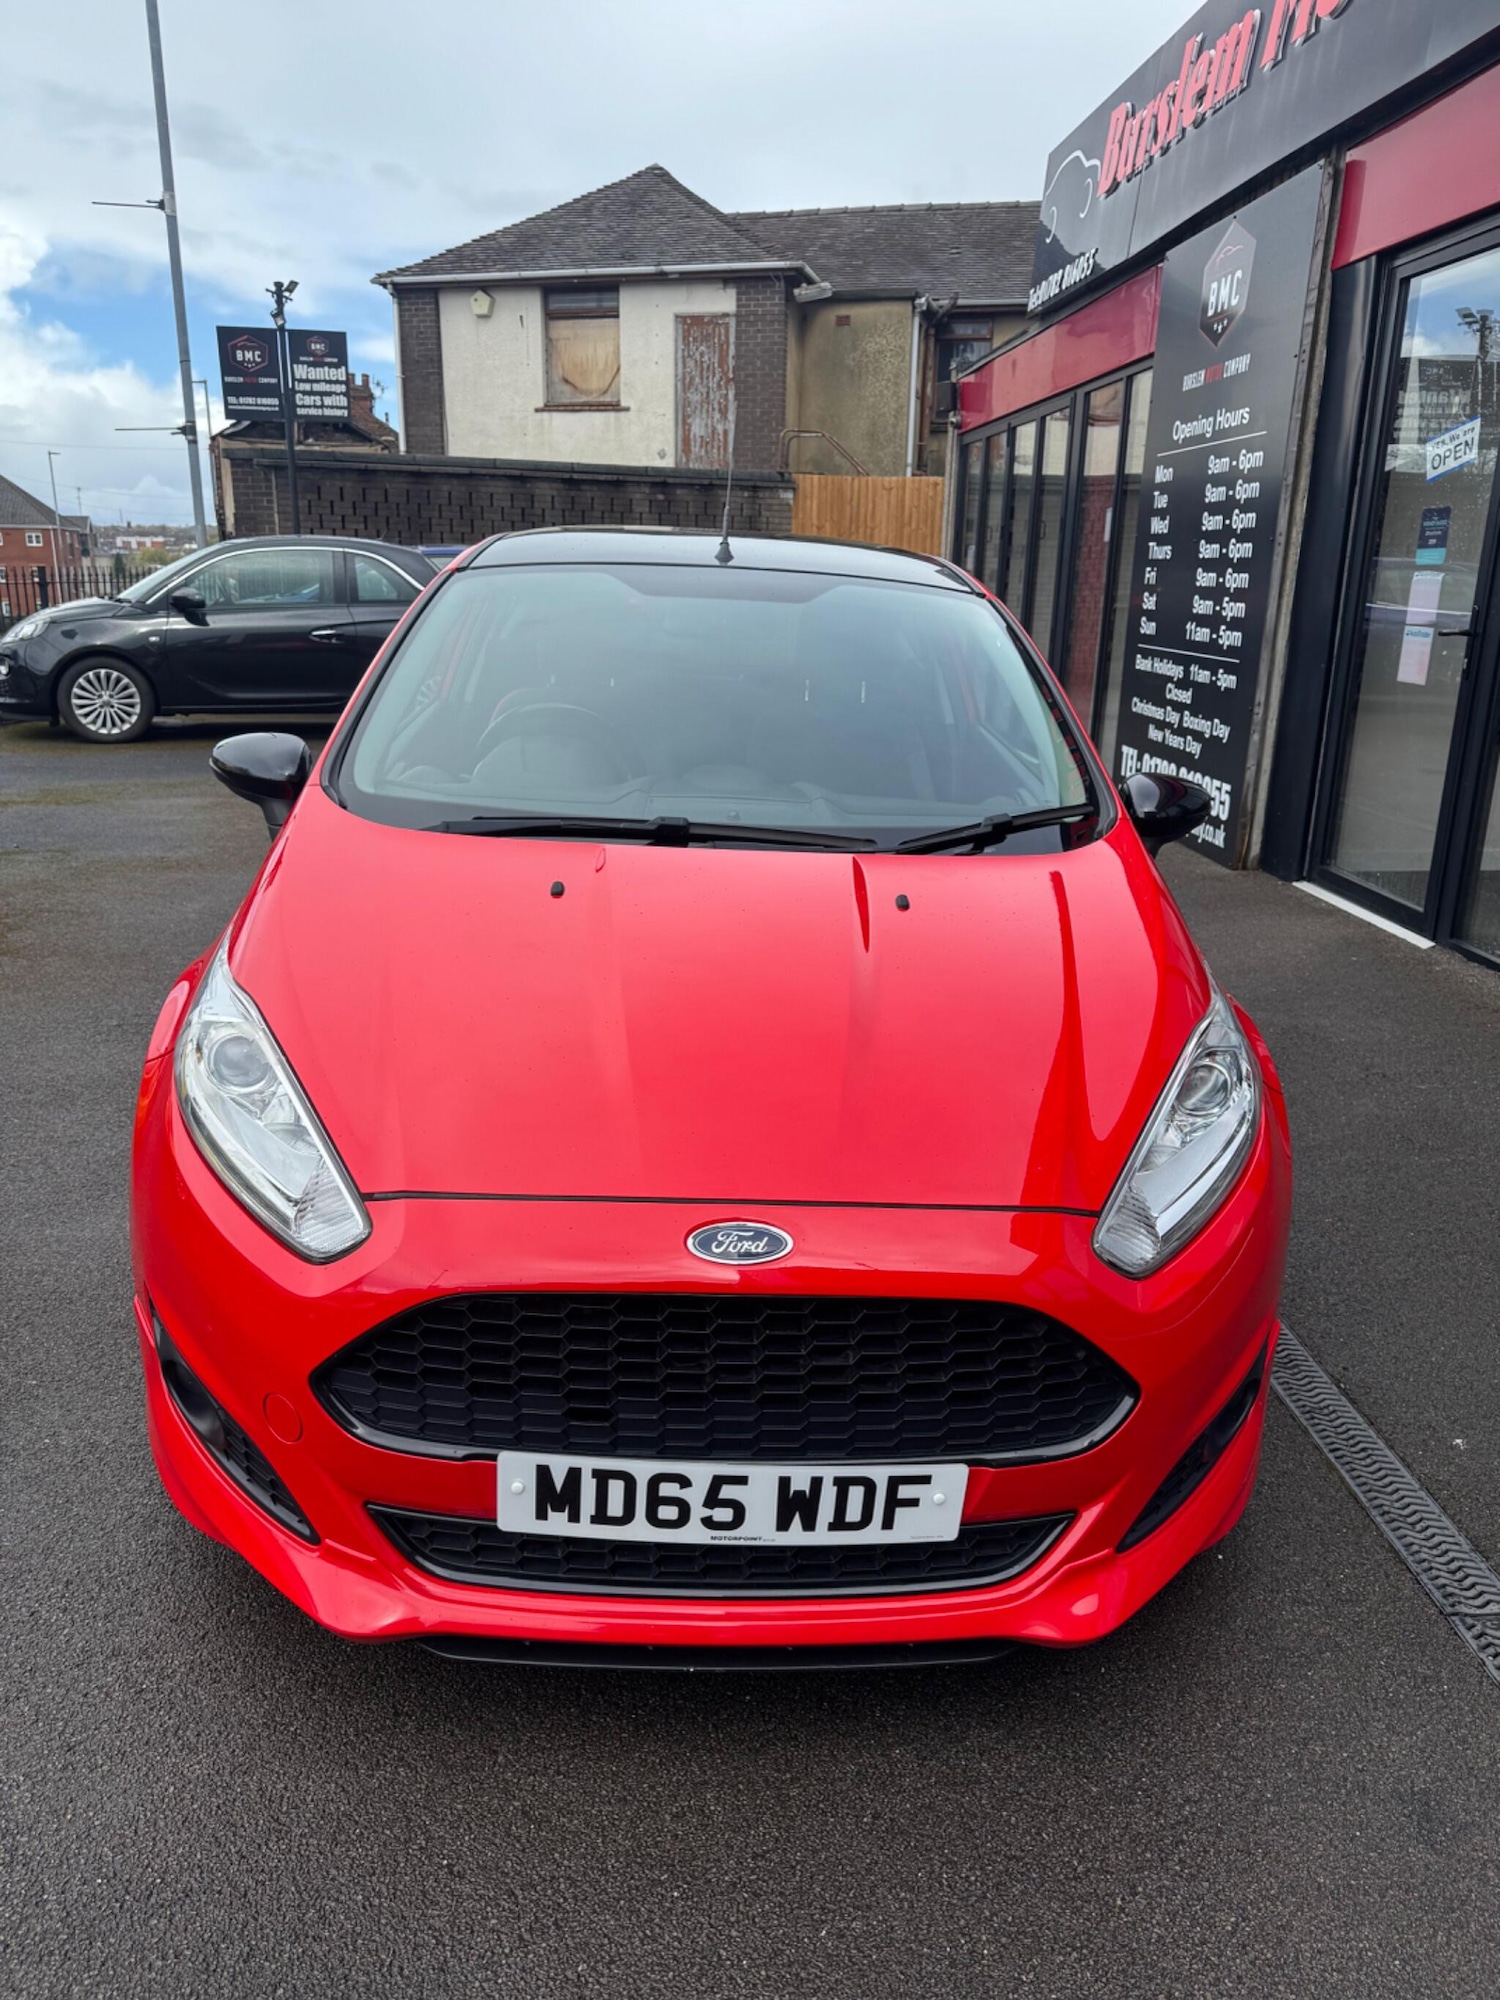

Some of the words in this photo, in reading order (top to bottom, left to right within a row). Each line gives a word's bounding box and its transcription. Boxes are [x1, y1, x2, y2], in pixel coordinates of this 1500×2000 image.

[1097, 9, 1260, 198] Burslem
[1207, 269, 1243, 318] BMC
[236, 349, 262, 362] BMC
[293, 363, 347, 381] Wanted
[294, 380, 312, 392] Low
[312, 381, 347, 393] mileage
[295, 393, 322, 407] Cars
[322, 394, 348, 407] with
[296, 407, 322, 417] service
[322, 408, 349, 418] history
[1172, 414, 1214, 445] Opening
[1215, 407, 1250, 431] Hours
[1155, 465, 1174, 484] Mon
[1207, 455, 1230, 475] 9am
[1238, 449, 1264, 474] 6pm
[1431, 437, 1475, 471] OPEN
[1153, 491, 1169, 509] Tue
[1204, 483, 1227, 504] 9am
[1235, 479, 1260, 504] 6pm
[1150, 515, 1170, 535] Wed
[1201, 511, 1223, 531] 9am
[1231, 508, 1257, 534] 6pm
[1148, 542, 1173, 560] Thurs
[1198, 539, 1220, 559] 9am
[1228, 538, 1253, 563] 6pm
[1144, 567, 1157, 585] Fri
[1195, 567, 1217, 587] 9am
[1225, 567, 1249, 593] 6pm
[1142, 591, 1157, 610] Sat
[1192, 594, 1214, 615] 9am
[1221, 596, 1246, 622] 5pm
[1139, 616, 1157, 636] Sun
[1185, 621, 1210, 643] 11am
[1218, 625, 1242, 650] 5pm
[1135, 653, 1153, 672] Bank
[1153, 656, 1184, 682] Holidays
[1189, 664, 1211, 684] 11am
[1216, 668, 1237, 691] 5pm
[1165, 682, 1193, 705] Closed
[1131, 696, 1165, 721] Christmas
[1165, 705, 1181, 729] Day
[1182, 710, 1212, 738] Boxing
[1212, 718, 1231, 743] Day
[1147, 723, 1165, 743] New
[1164, 728, 1185, 750] Years
[1185, 735, 1202, 760] Day
[711, 1229, 769, 1254] Ford
[534, 1464, 749, 1532] MD65
[775, 1474, 933, 1533] WDF
